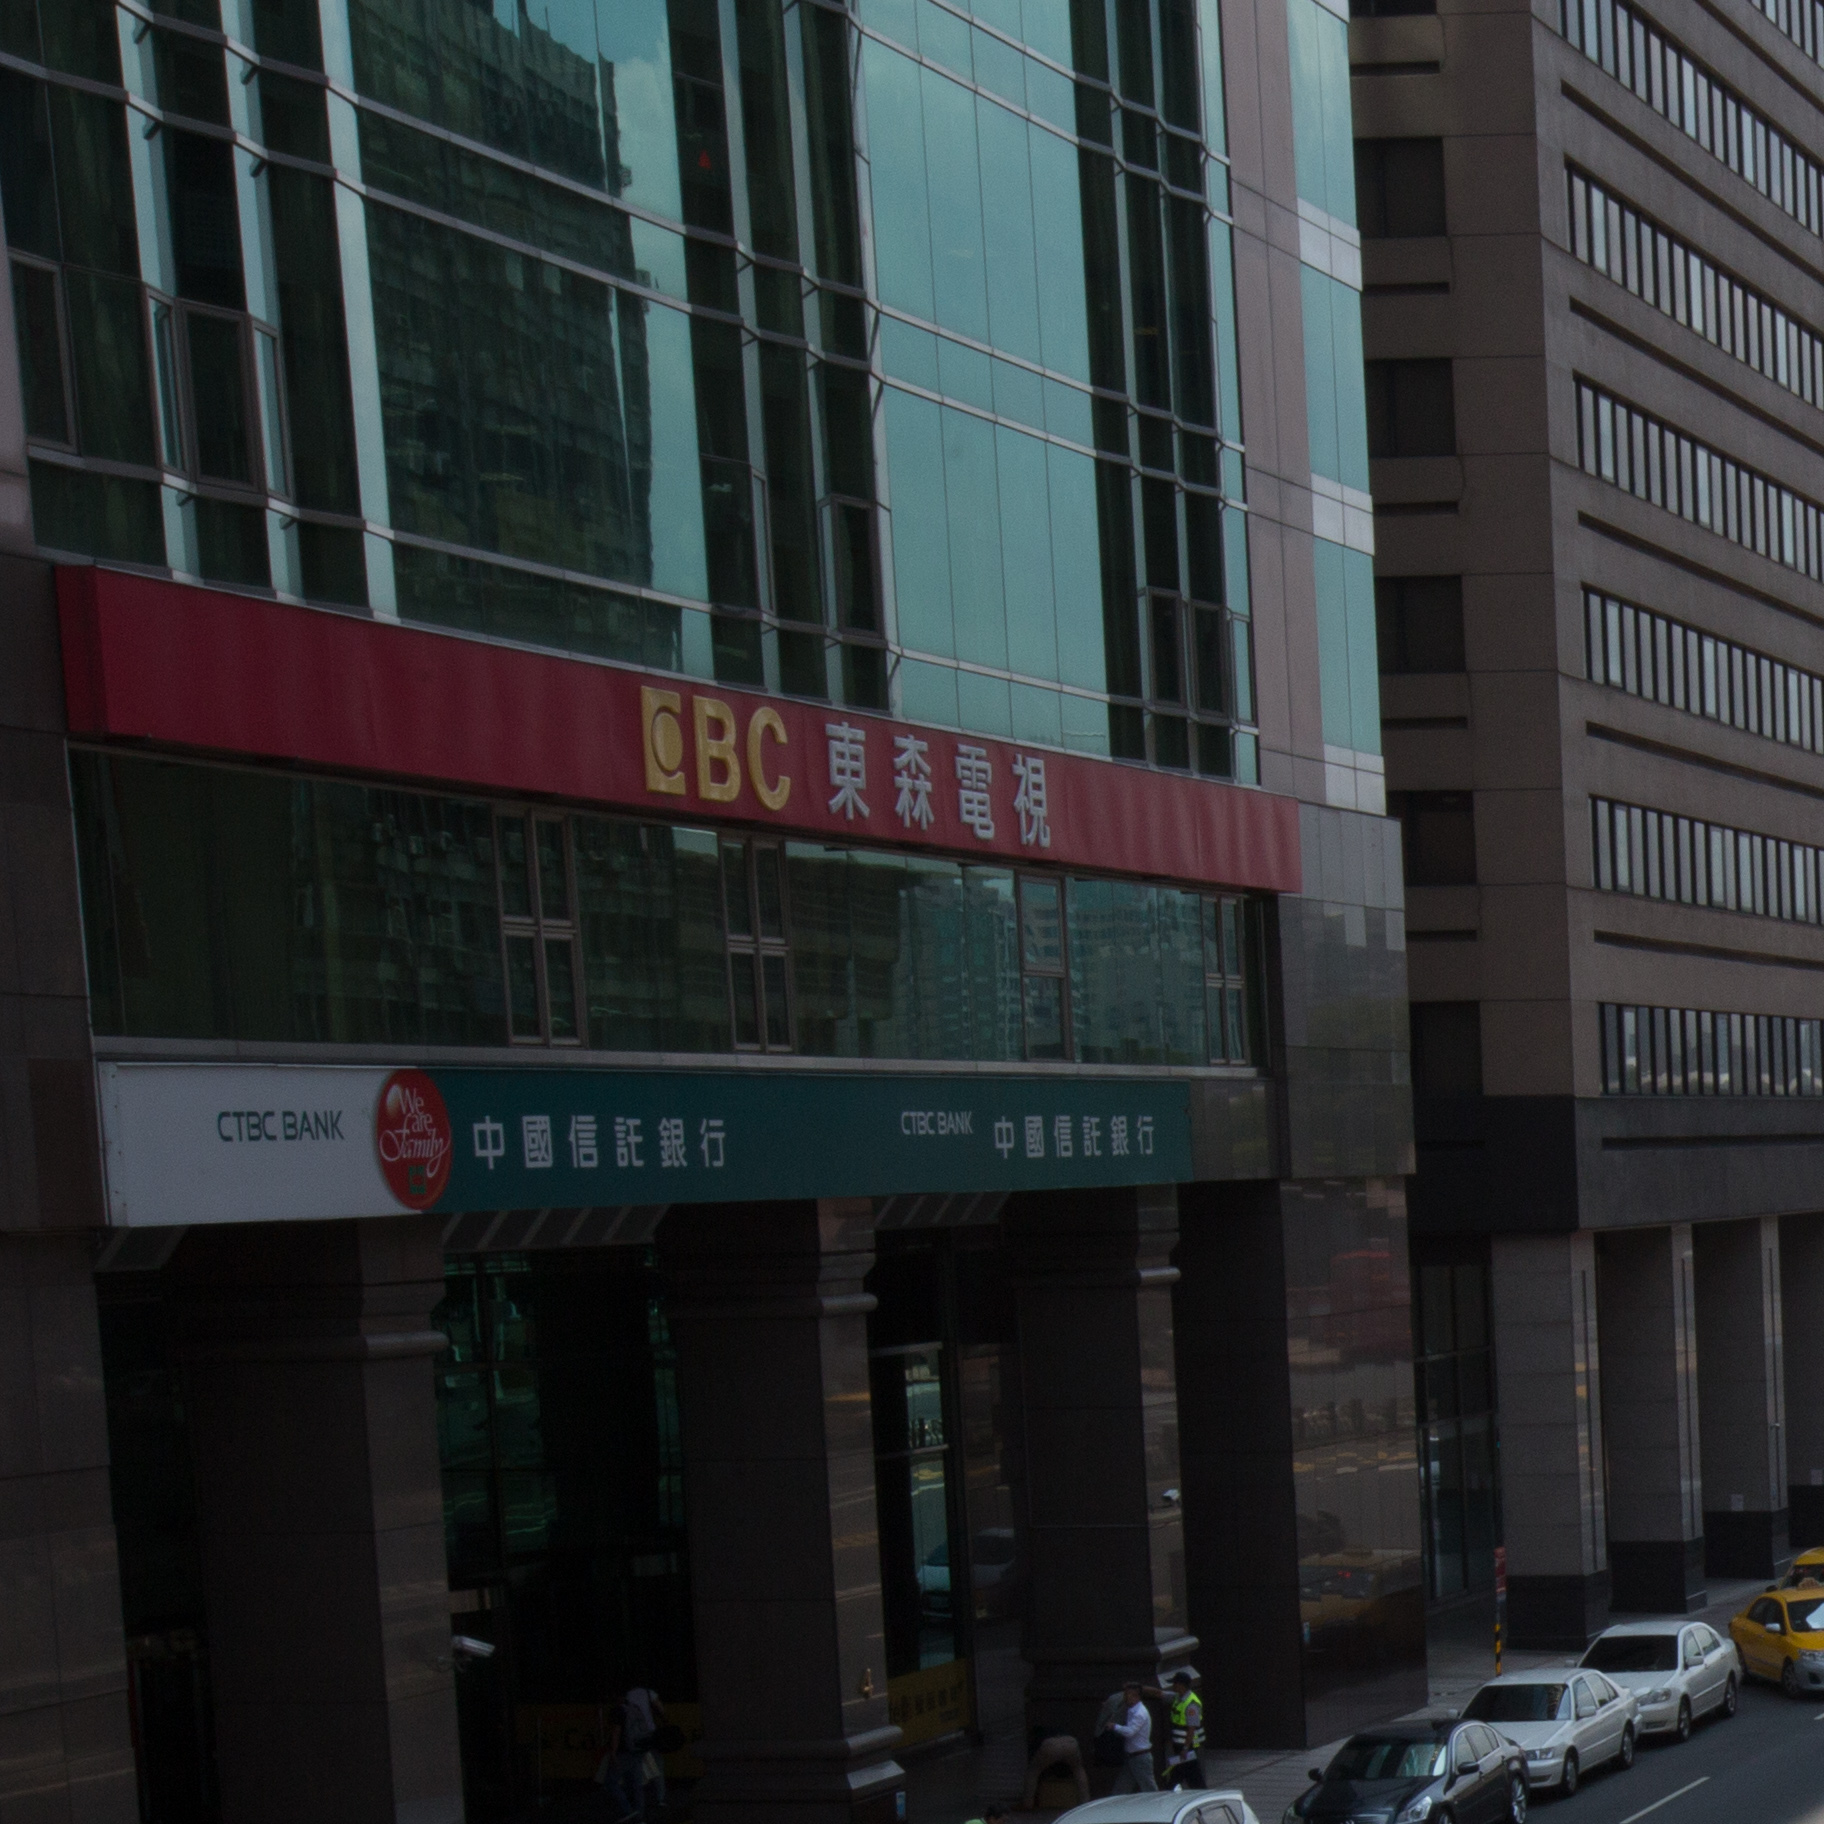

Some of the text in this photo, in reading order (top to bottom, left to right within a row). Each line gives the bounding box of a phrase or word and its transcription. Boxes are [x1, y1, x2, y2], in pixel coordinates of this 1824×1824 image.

[825, 721, 1051, 849] 東森電視
[400, 1088, 425, 1114] We
[217, 1110, 345, 1142] CTBC BANK
[900, 1110, 974, 1135] CTBC BANK
[993, 1115, 1155, 1160] 中國信託銀行
[472, 1114, 727, 1170] 中國信託銀行
